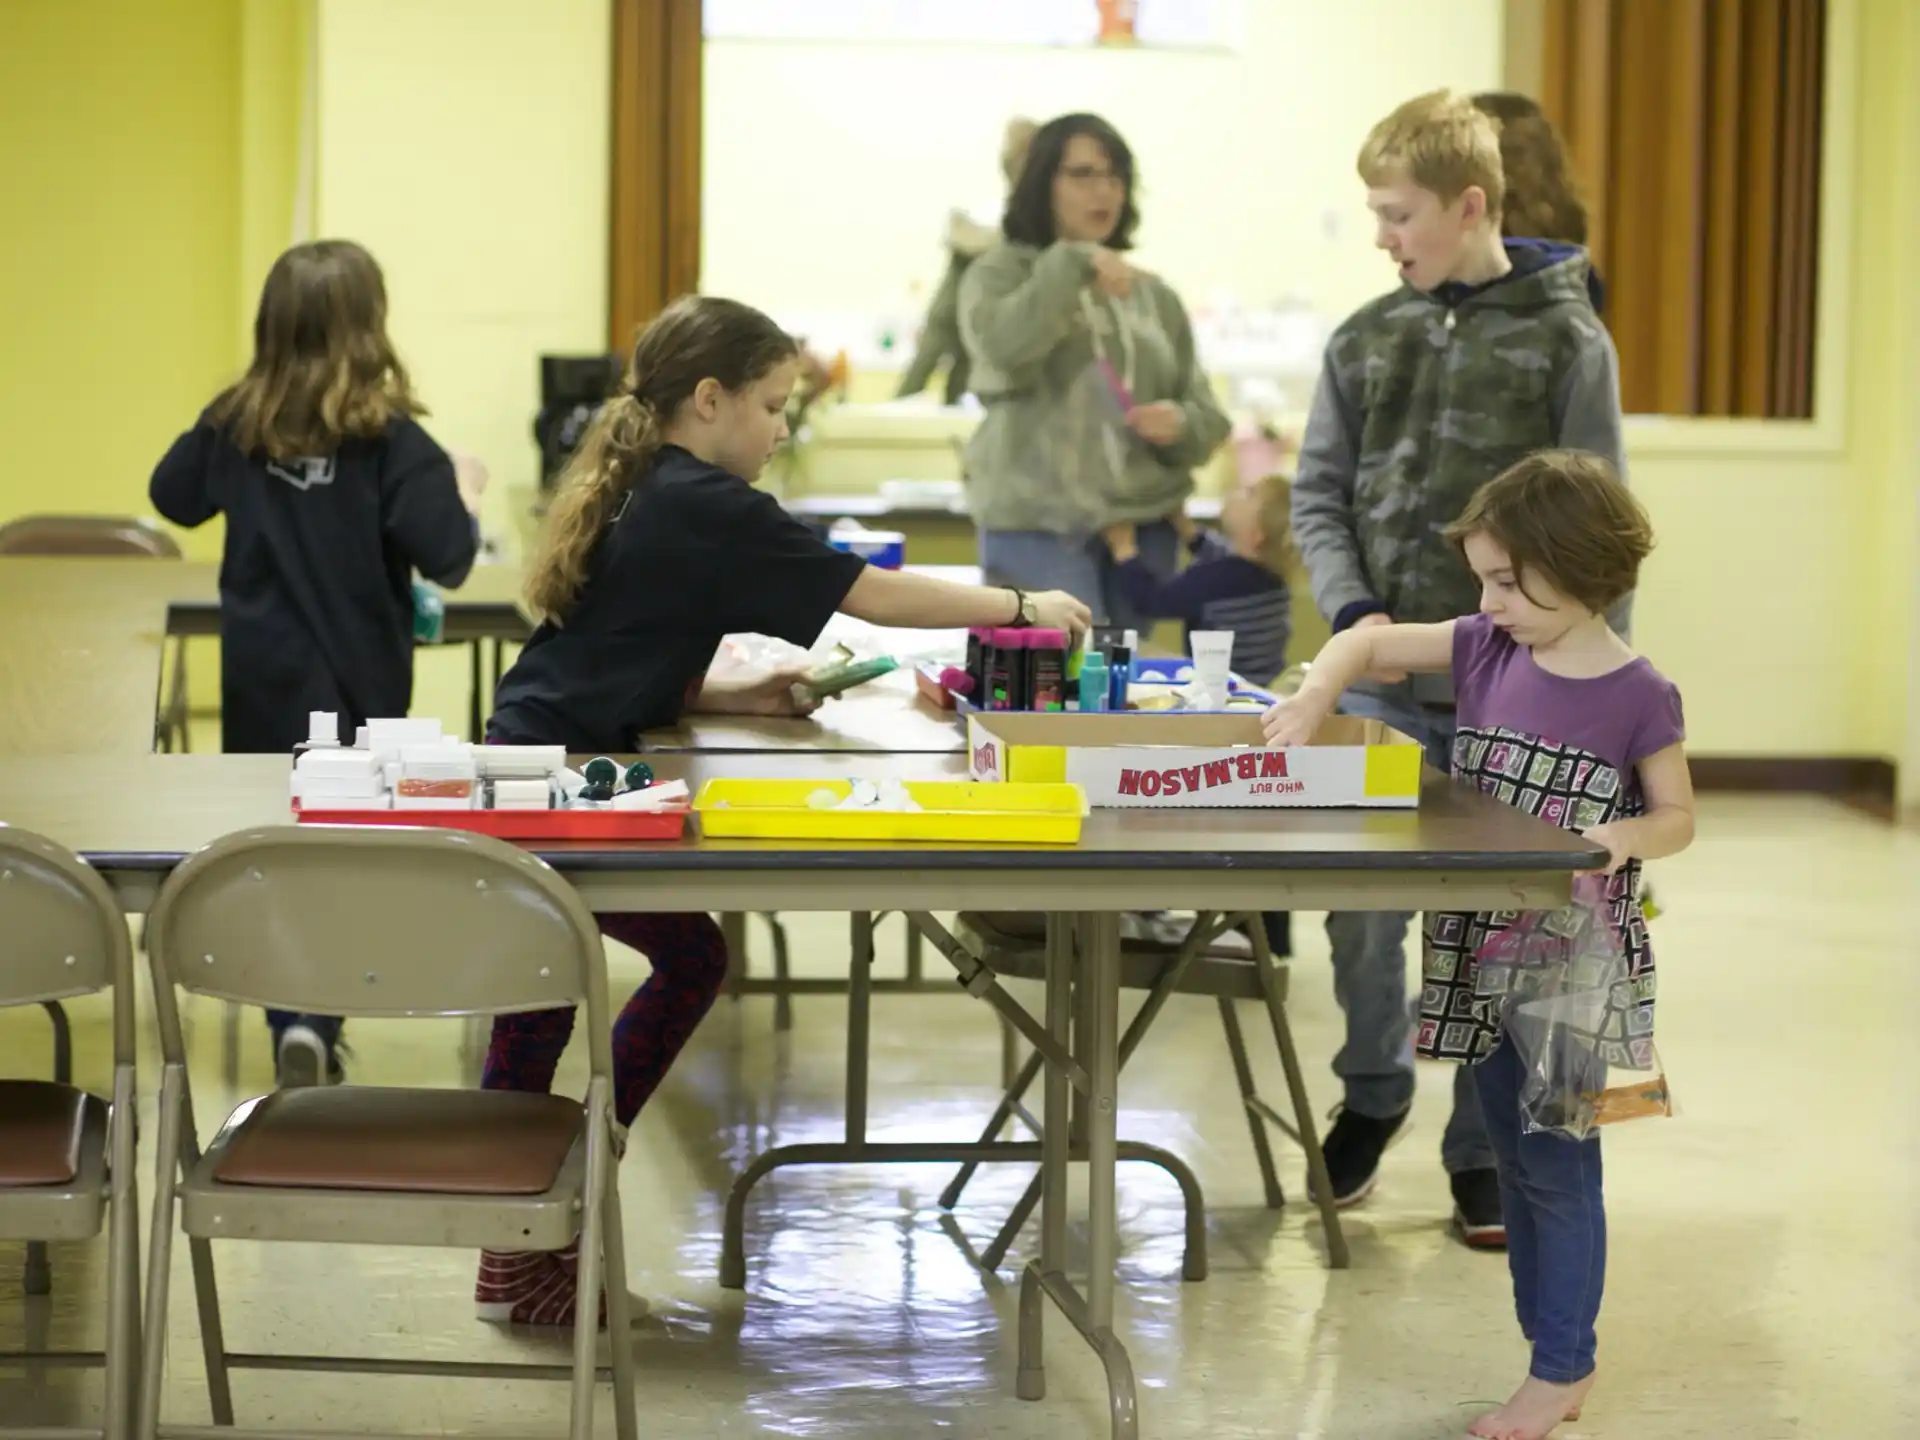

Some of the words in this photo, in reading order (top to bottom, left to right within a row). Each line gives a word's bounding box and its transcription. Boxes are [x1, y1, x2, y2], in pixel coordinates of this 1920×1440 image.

[1250, 782, 1273, 796] BUT
[1276, 780, 1305, 794] WHO
[1443, 918, 1457, 936] F
[1450, 1026, 1464, 1043] H
